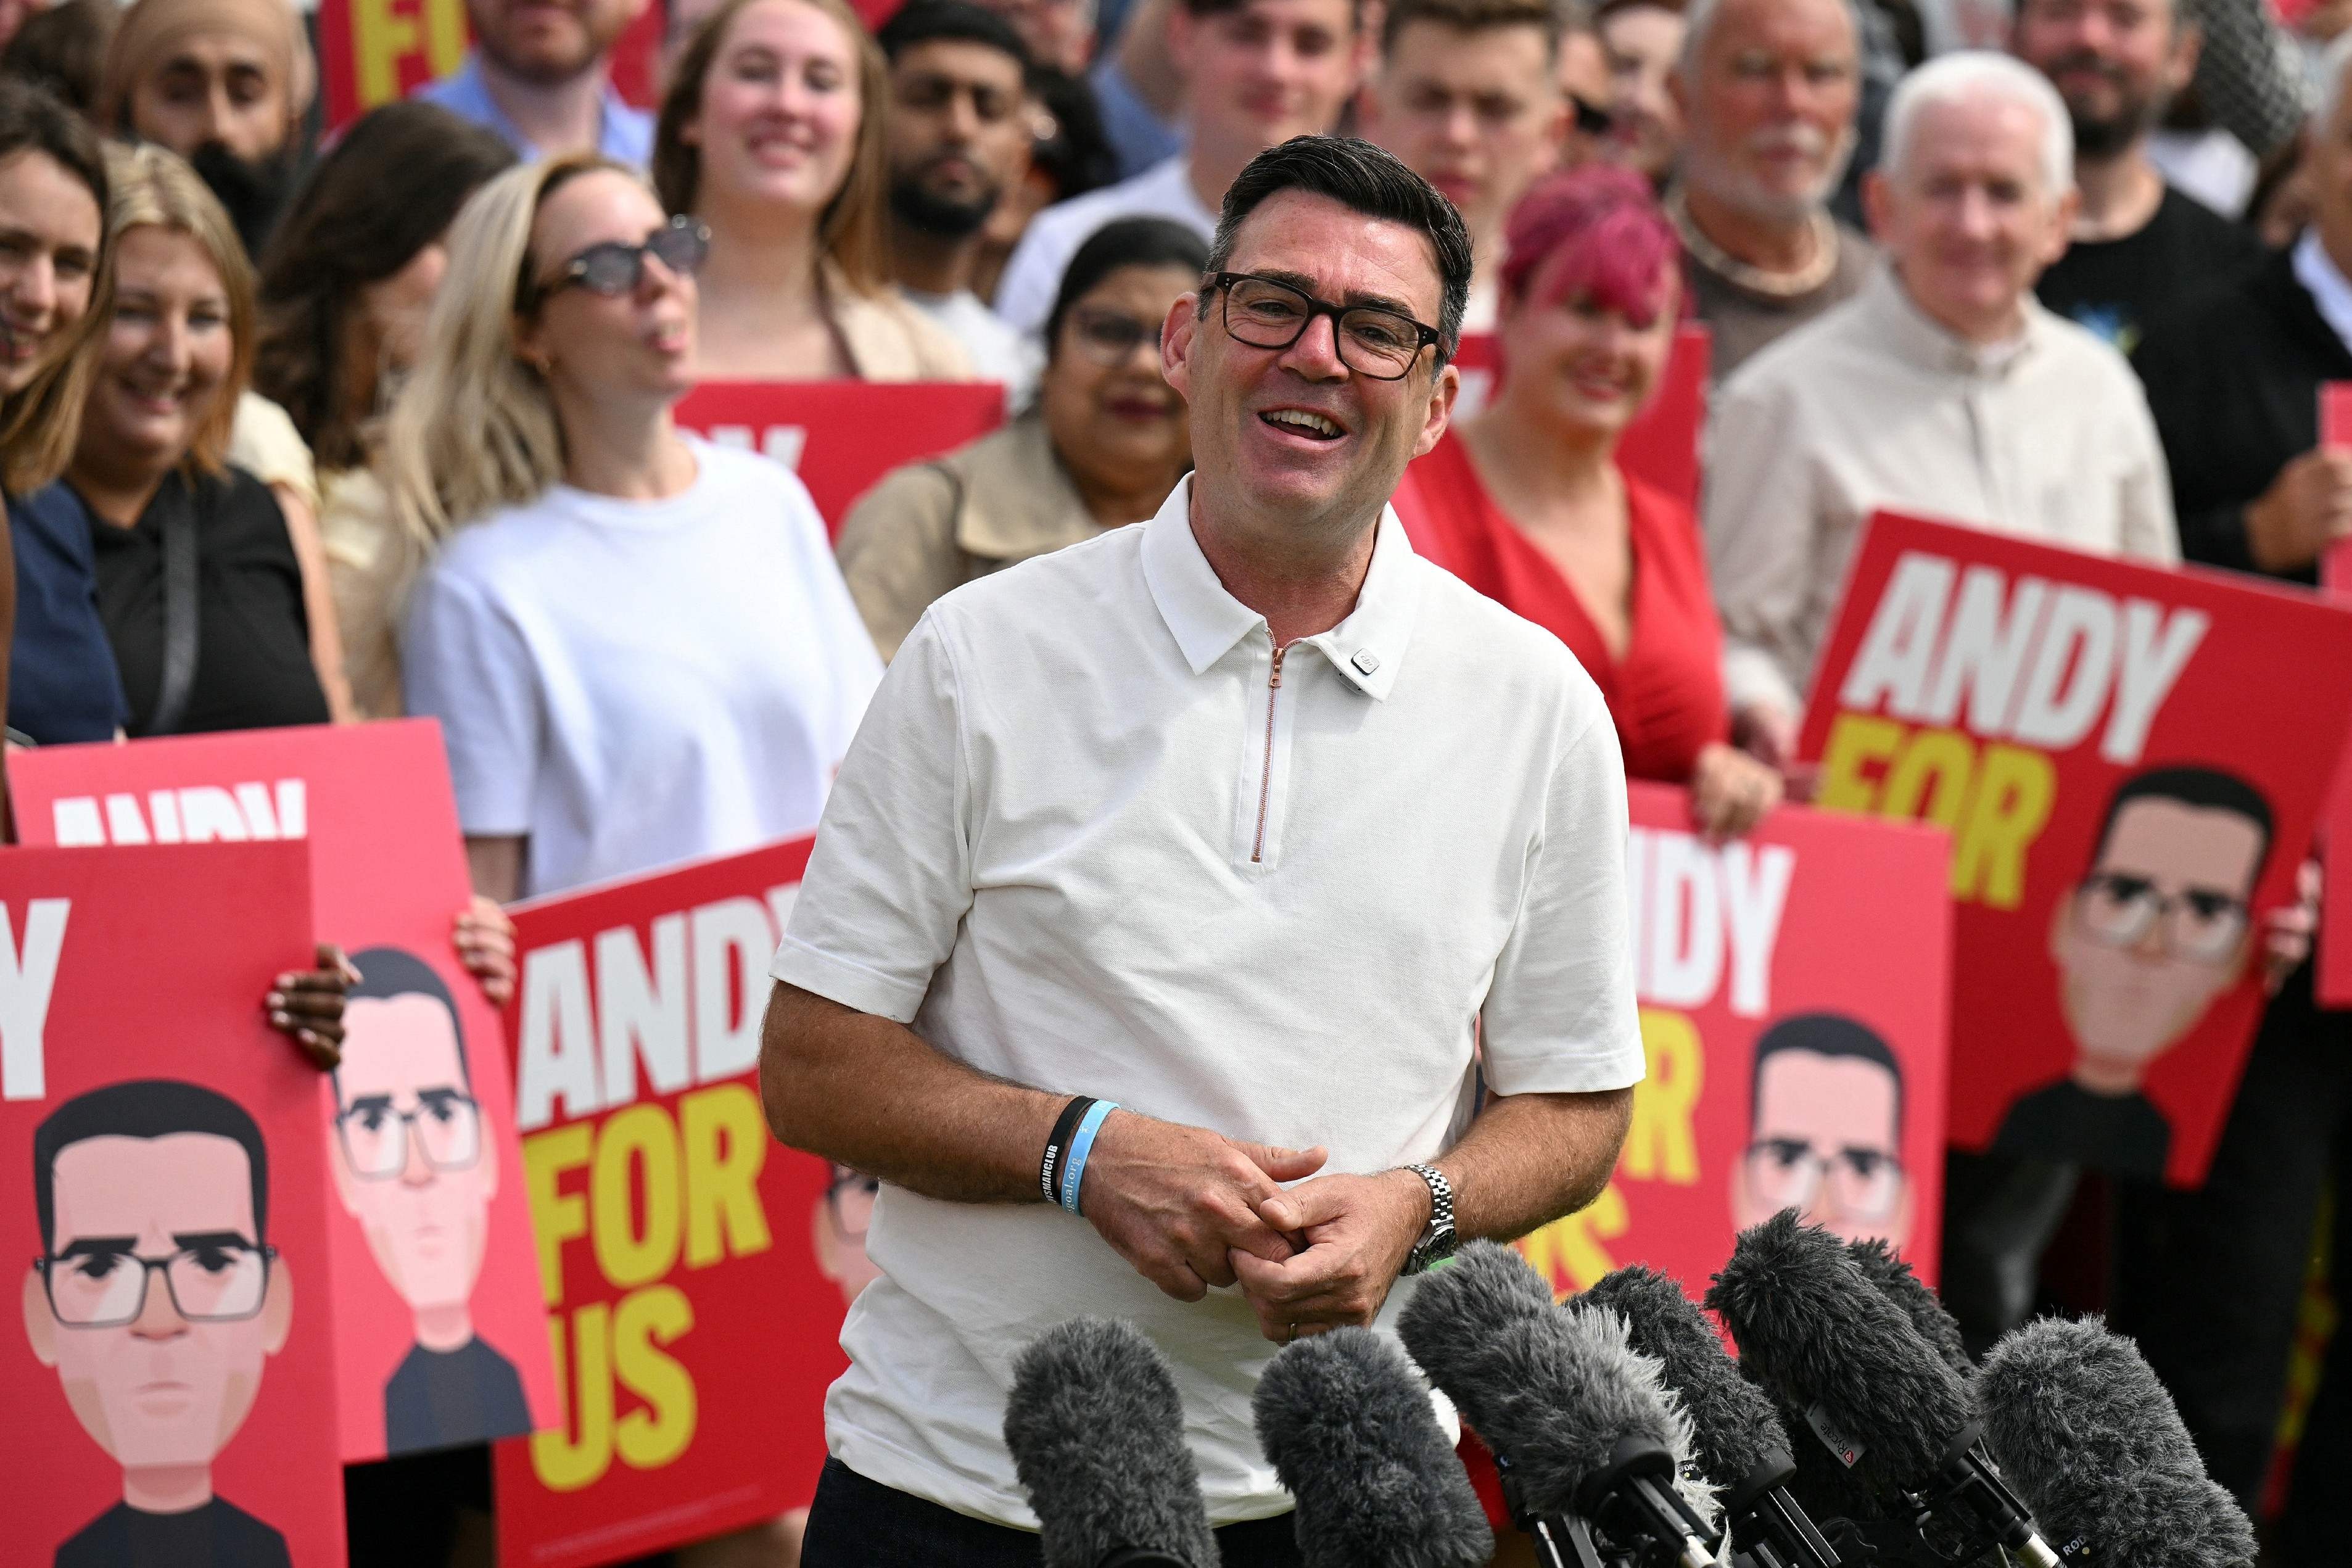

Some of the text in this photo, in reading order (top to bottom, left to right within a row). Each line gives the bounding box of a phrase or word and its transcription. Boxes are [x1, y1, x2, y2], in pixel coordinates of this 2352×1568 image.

[1841, 552, 2208, 765] ANDY
[1817, 712, 2055, 908] FOR
[518, 881, 802, 1131] AND
[523, 1084, 772, 1305] FOR
[532, 1286, 696, 1490] US
[1820, 1422, 1847, 1455] Rycote
